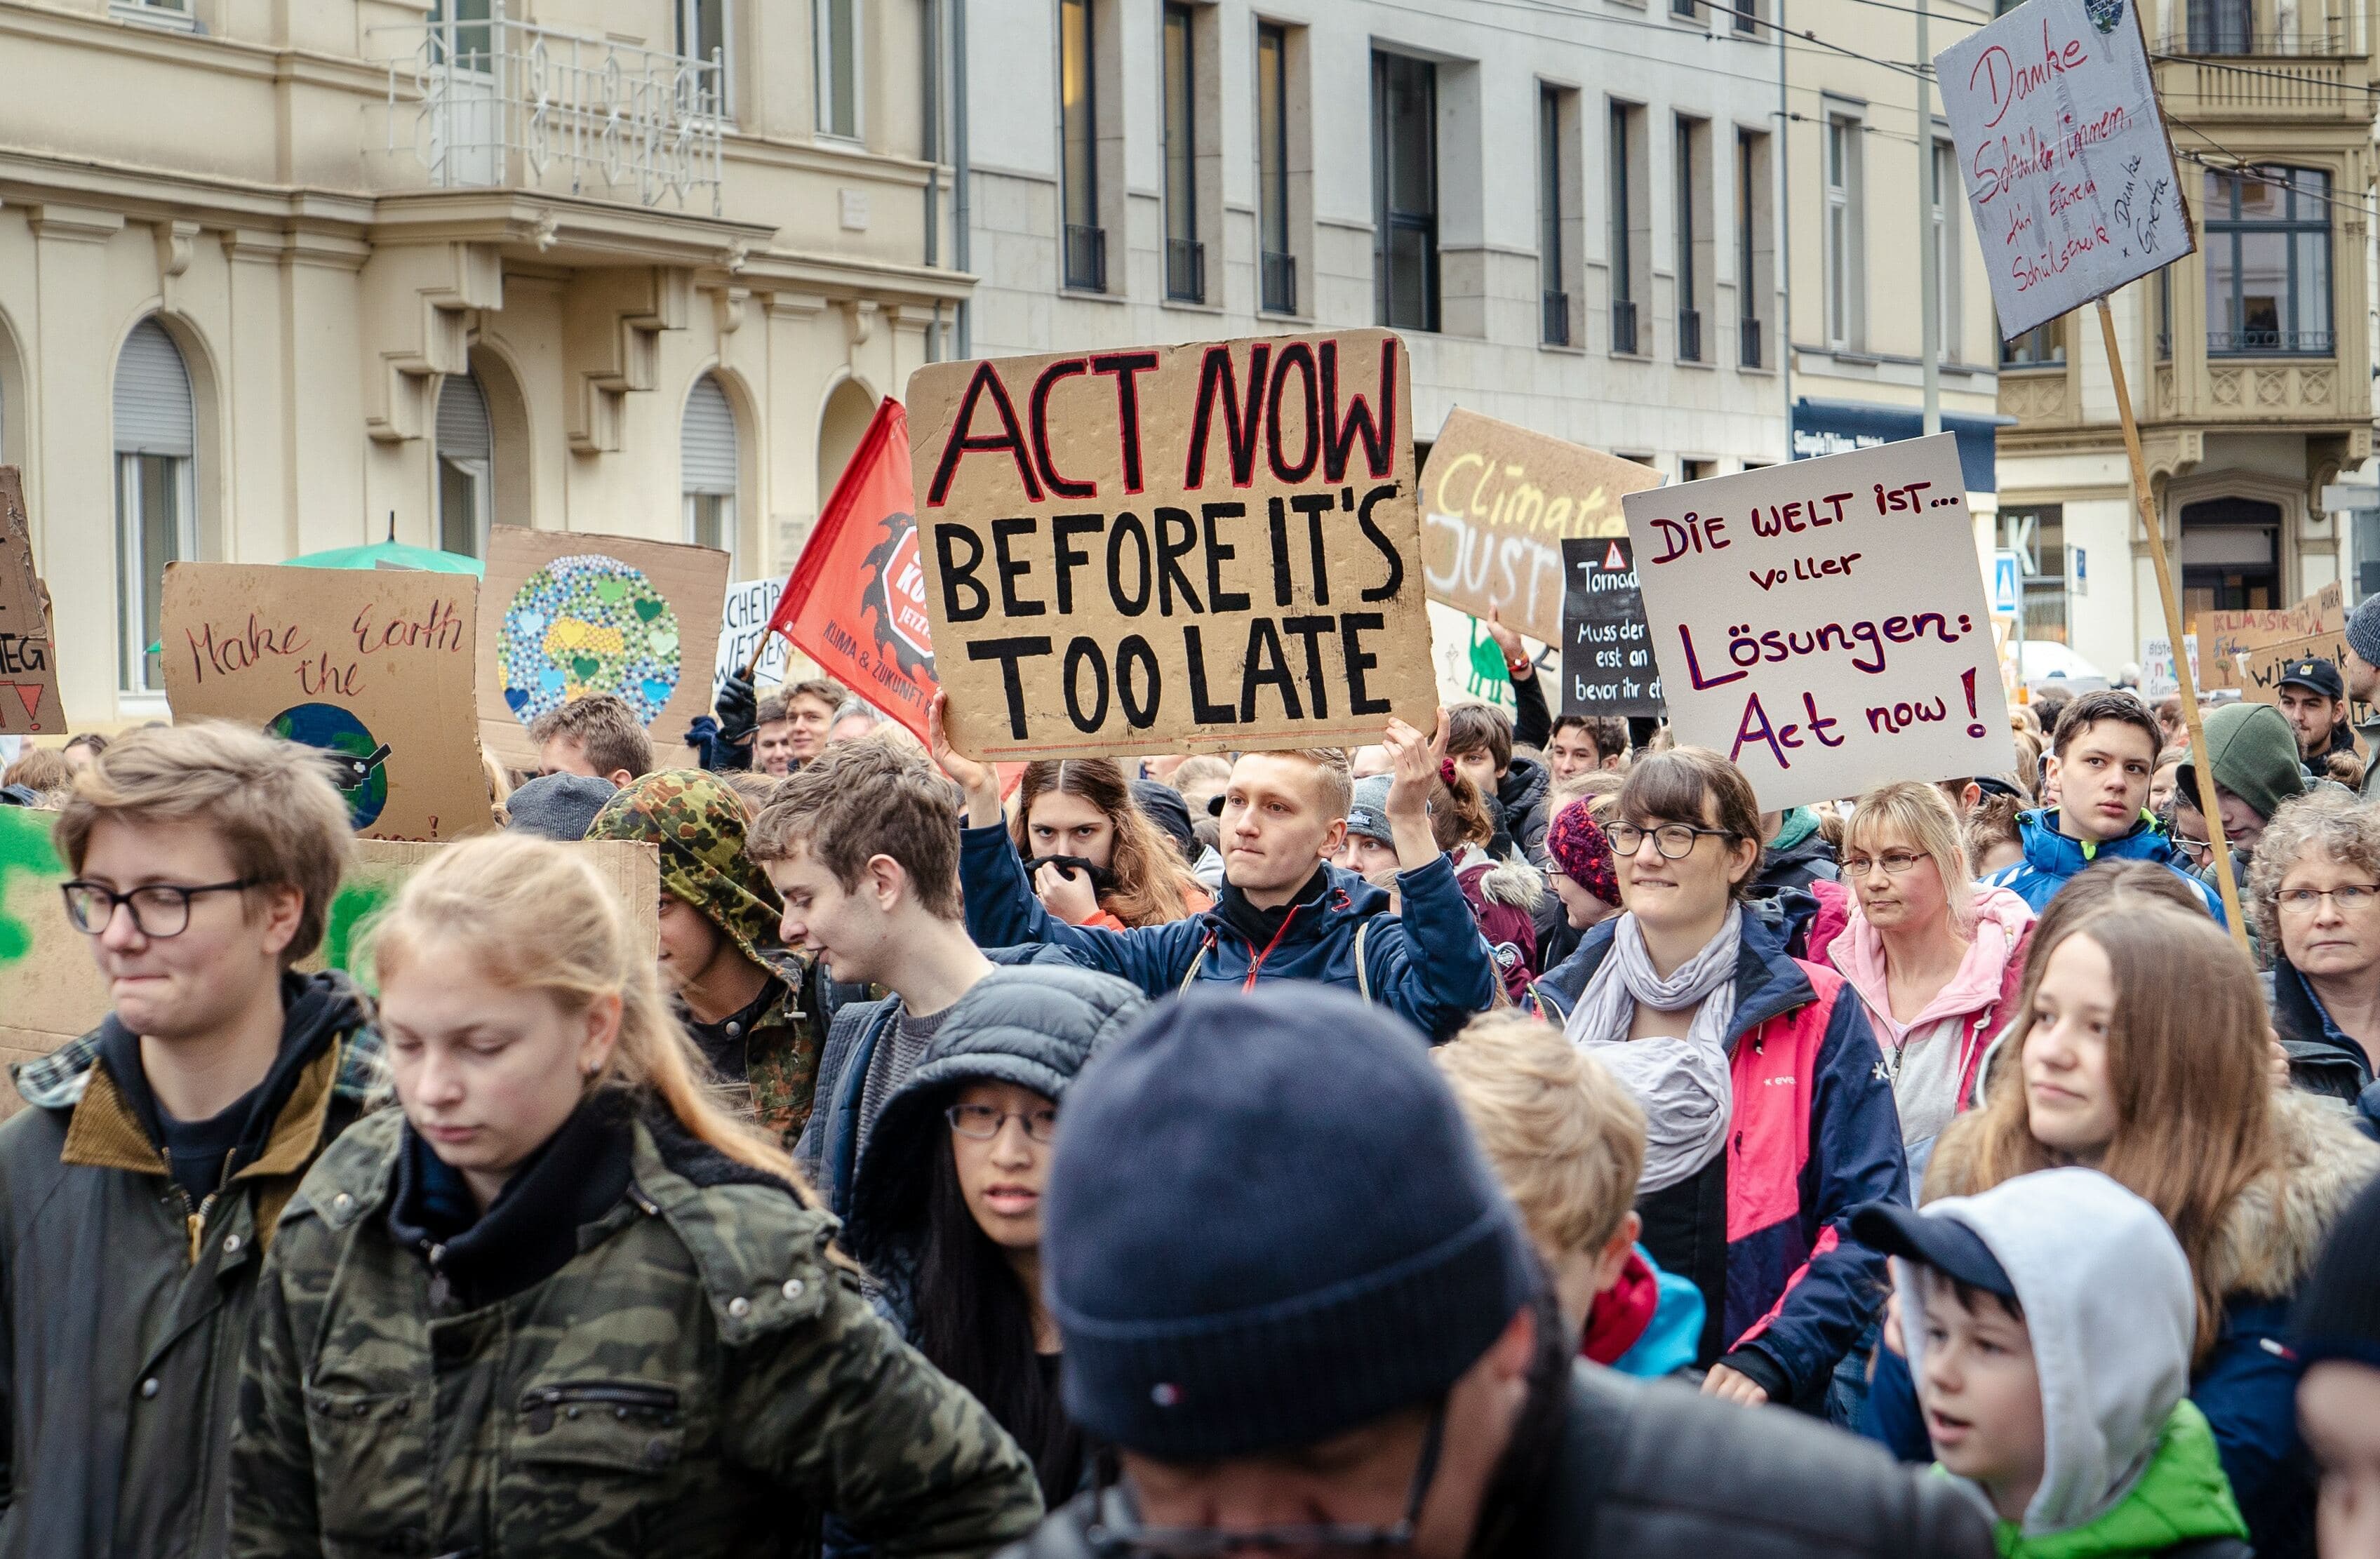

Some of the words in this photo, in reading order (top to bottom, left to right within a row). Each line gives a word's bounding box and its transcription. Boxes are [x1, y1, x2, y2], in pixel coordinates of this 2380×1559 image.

[1970, 18, 2088, 127] Danke
[926, 352, 1160, 507] ACT
[1184, 338, 1398, 490] NOW
[933, 502, 1251, 622] BEFORE
[1268, 484, 1405, 608] IT'S
[1751, 493, 1854, 537] WELT
[1425, 513, 1563, 630] JUST
[185, 613, 312, 685] Make
[352, 598, 463, 654] Earth
[822, 619, 857, 660] KLIMA
[858, 650, 869, 671] &
[871, 660, 925, 709] ZUKUNFT
[1577, 622, 1617, 644] Muss
[1619, 618, 1645, 641] der
[1596, 646, 1622, 668] erst
[1629, 649, 1648, 667] an
[1678, 613, 1972, 691] Lösungen:
[295, 651, 367, 697] the
[966, 634, 1162, 740] TOO
[1184, 612, 1393, 725] LATE
[1575, 674, 1619, 701] bevor
[1622, 676, 1640, 699] ihr
[1649, 676, 1663, 699] et
[1730, 692, 1845, 770] Act
[1774, 1076, 1797, 1086] eve
